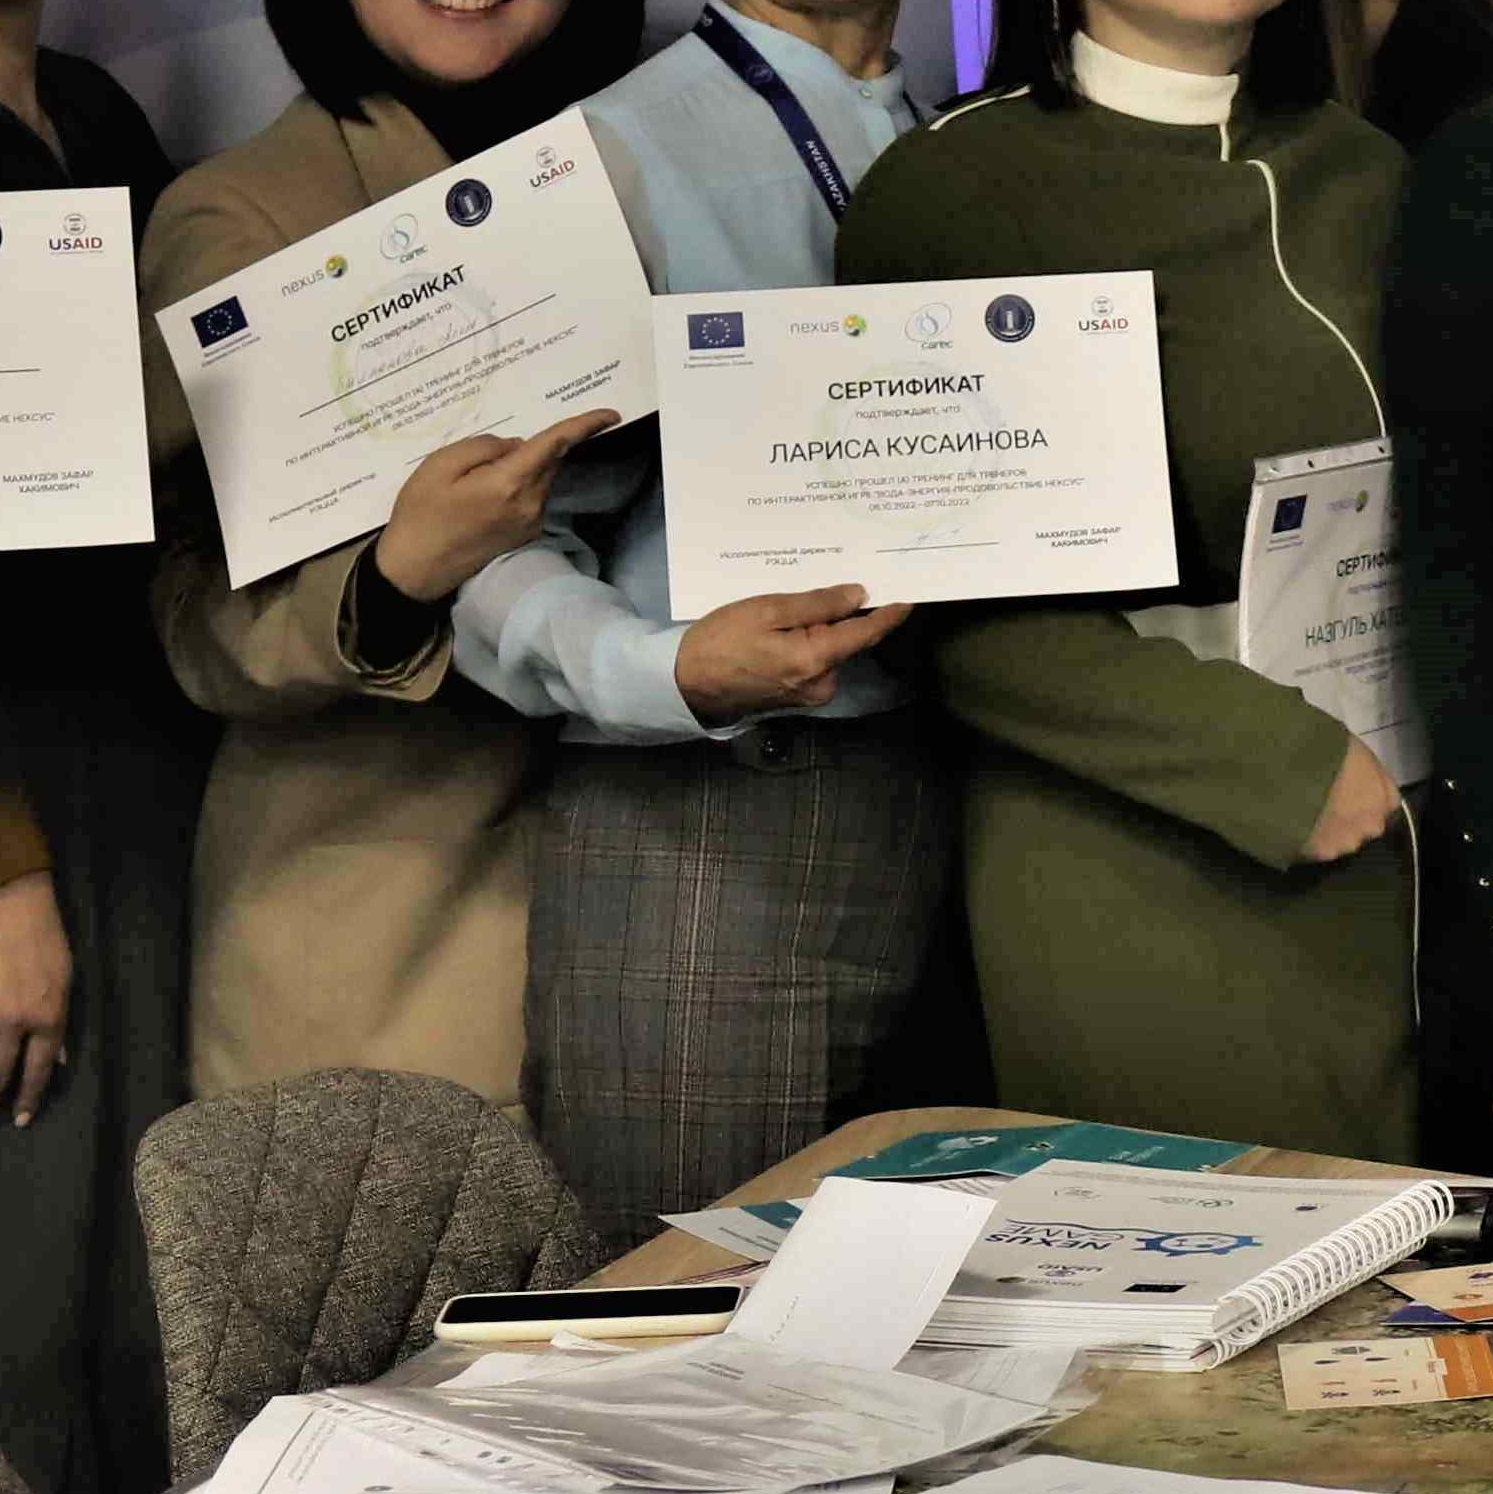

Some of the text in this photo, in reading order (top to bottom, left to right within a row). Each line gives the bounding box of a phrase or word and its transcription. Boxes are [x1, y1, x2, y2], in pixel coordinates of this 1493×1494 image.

[529, 159, 576, 189] USAID
[49, 236, 104, 251] USAID
[280, 269, 326, 298] nexus
[331, 264, 466, 343] СЕРТИФИКАТ
[788, 318, 840, 335] nexus
[1078, 317, 1129, 333] USAID
[827, 374, 985, 401] СЕРТИФИКАТ
[769, 428, 1049, 464] ЛАРИСА КУСАИНОВА
[1305, 610, 1368, 649] НАЗГУЛЬ
[984, 1233, 1112, 1251] NEXUS
